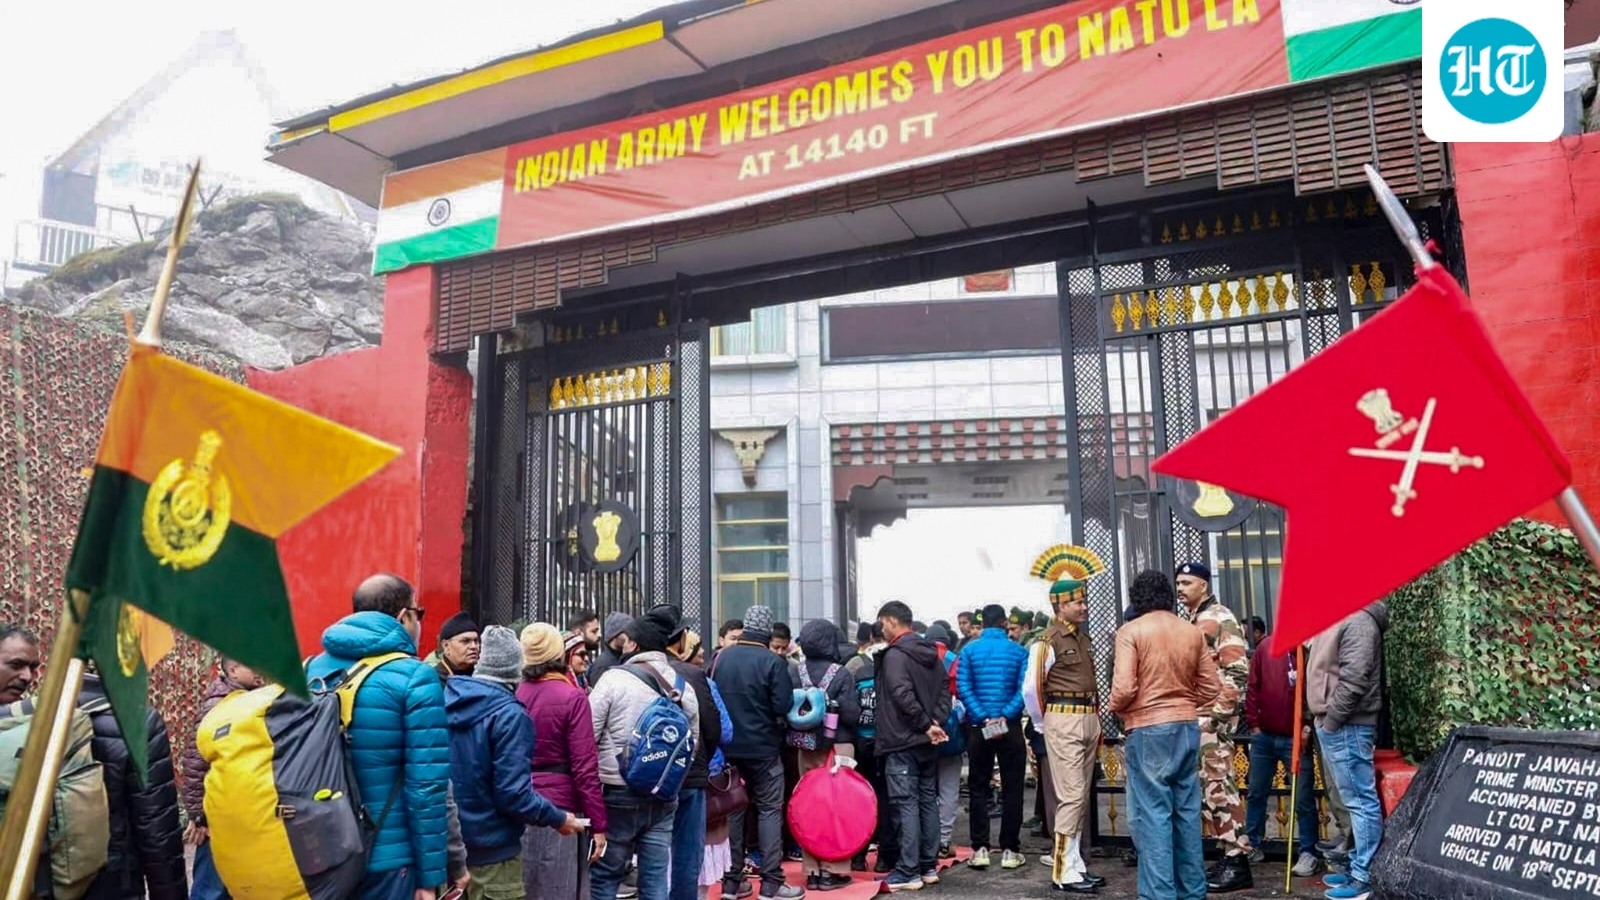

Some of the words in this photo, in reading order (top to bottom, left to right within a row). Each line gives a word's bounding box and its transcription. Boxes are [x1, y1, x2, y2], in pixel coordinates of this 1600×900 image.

[514, 140, 607, 193] INDIAN
[616, 113, 707, 171] ARMY
[719, 61, 913, 146] WELCOMES
[927, 36, 1003, 94] YOU
[1015, 23, 1066, 73] TO
[1078, 0, 1190, 60] NATU
[1204, 0, 1260, 32] LA
[738, 151, 776, 181] AT
[783, 124, 888, 170] 14140
[899, 113, 939, 144] FT
[641, 750, 668, 763] adidas
[1462, 748, 1526, 769] PANDIT
[1475, 769, 1518, 789] PRIME
[1523, 774, 1598, 799] MINISTER
[1468, 788, 1576, 817] ACCOMPANIED
[1486, 810, 1506, 828] LT
[1508, 813, 1536, 832] COL
[1540, 817, 1554, 834] P
[1557, 819, 1570, 836] T
[1439, 841, 1491, 867] VEHICLE
[1492, 854, 1514, 872] ON
[1445, 824, 1501, 847] ARRIVED
[1504, 834, 1528, 852] AT
[1529, 838, 1573, 862] NATU
[1573, 847, 1596, 867] LA
